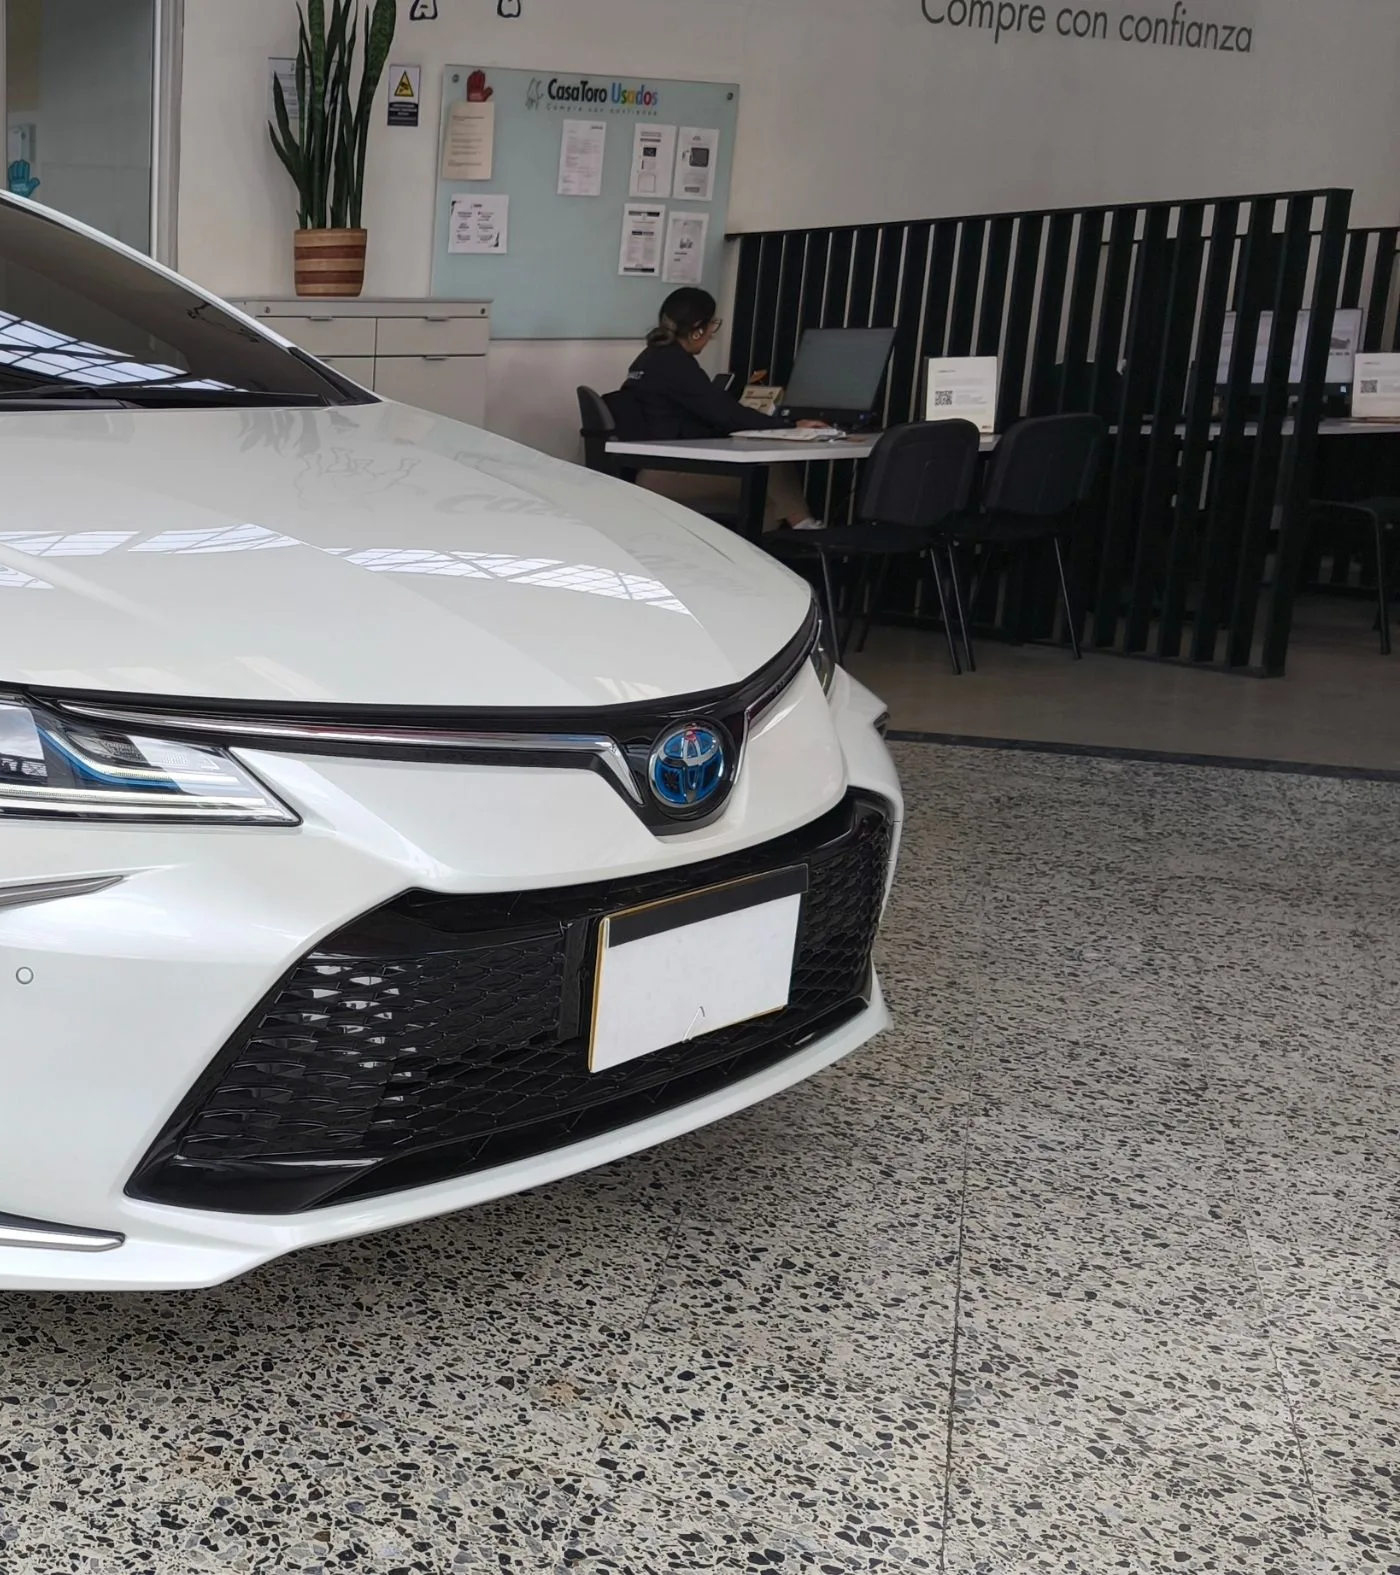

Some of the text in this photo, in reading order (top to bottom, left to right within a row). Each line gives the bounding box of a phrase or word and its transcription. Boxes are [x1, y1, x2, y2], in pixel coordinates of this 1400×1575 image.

[921, 0, 1254, 53] Compre con confianza
[547, 78, 659, 106] CasaToro Usados
